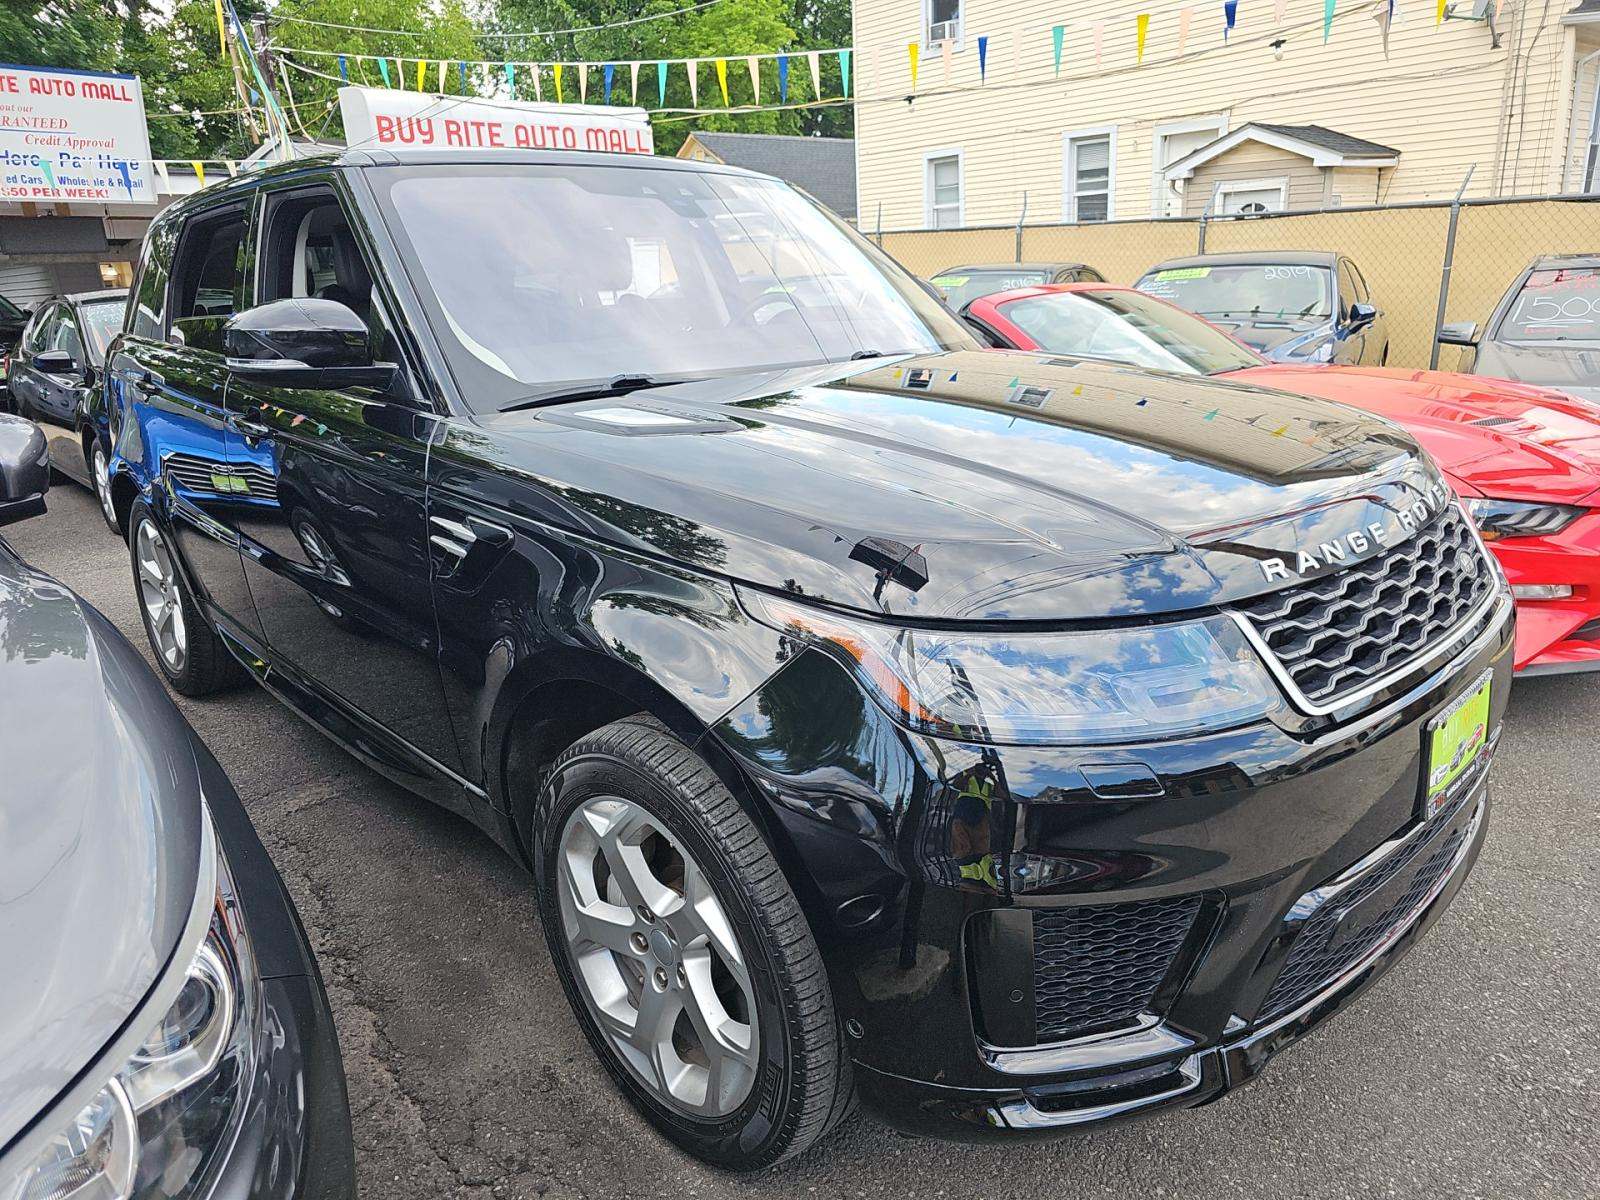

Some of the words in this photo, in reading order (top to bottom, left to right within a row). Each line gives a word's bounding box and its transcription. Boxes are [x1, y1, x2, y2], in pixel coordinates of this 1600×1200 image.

[29, 77, 76, 97] AUTO
[82, 82, 132, 102] MALL
[25, 133, 61, 146] Credit
[64, 136, 115, 150] Approval
[375, 115, 435, 144] BUY
[443, 119, 505, 148] RITE
[514, 124, 577, 149] AUTO
[585, 127, 651, 154] MALL
[98, 154, 139, 170] Hee
[20, 174, 43, 185] Cars
[108, 177, 114, 187] &
[32, 187, 61, 197] PER
[65, 188, 109, 199] WEEK!
[1263, 265, 1313, 281] 2019
[1259, 522, 1389, 583] RANGE
